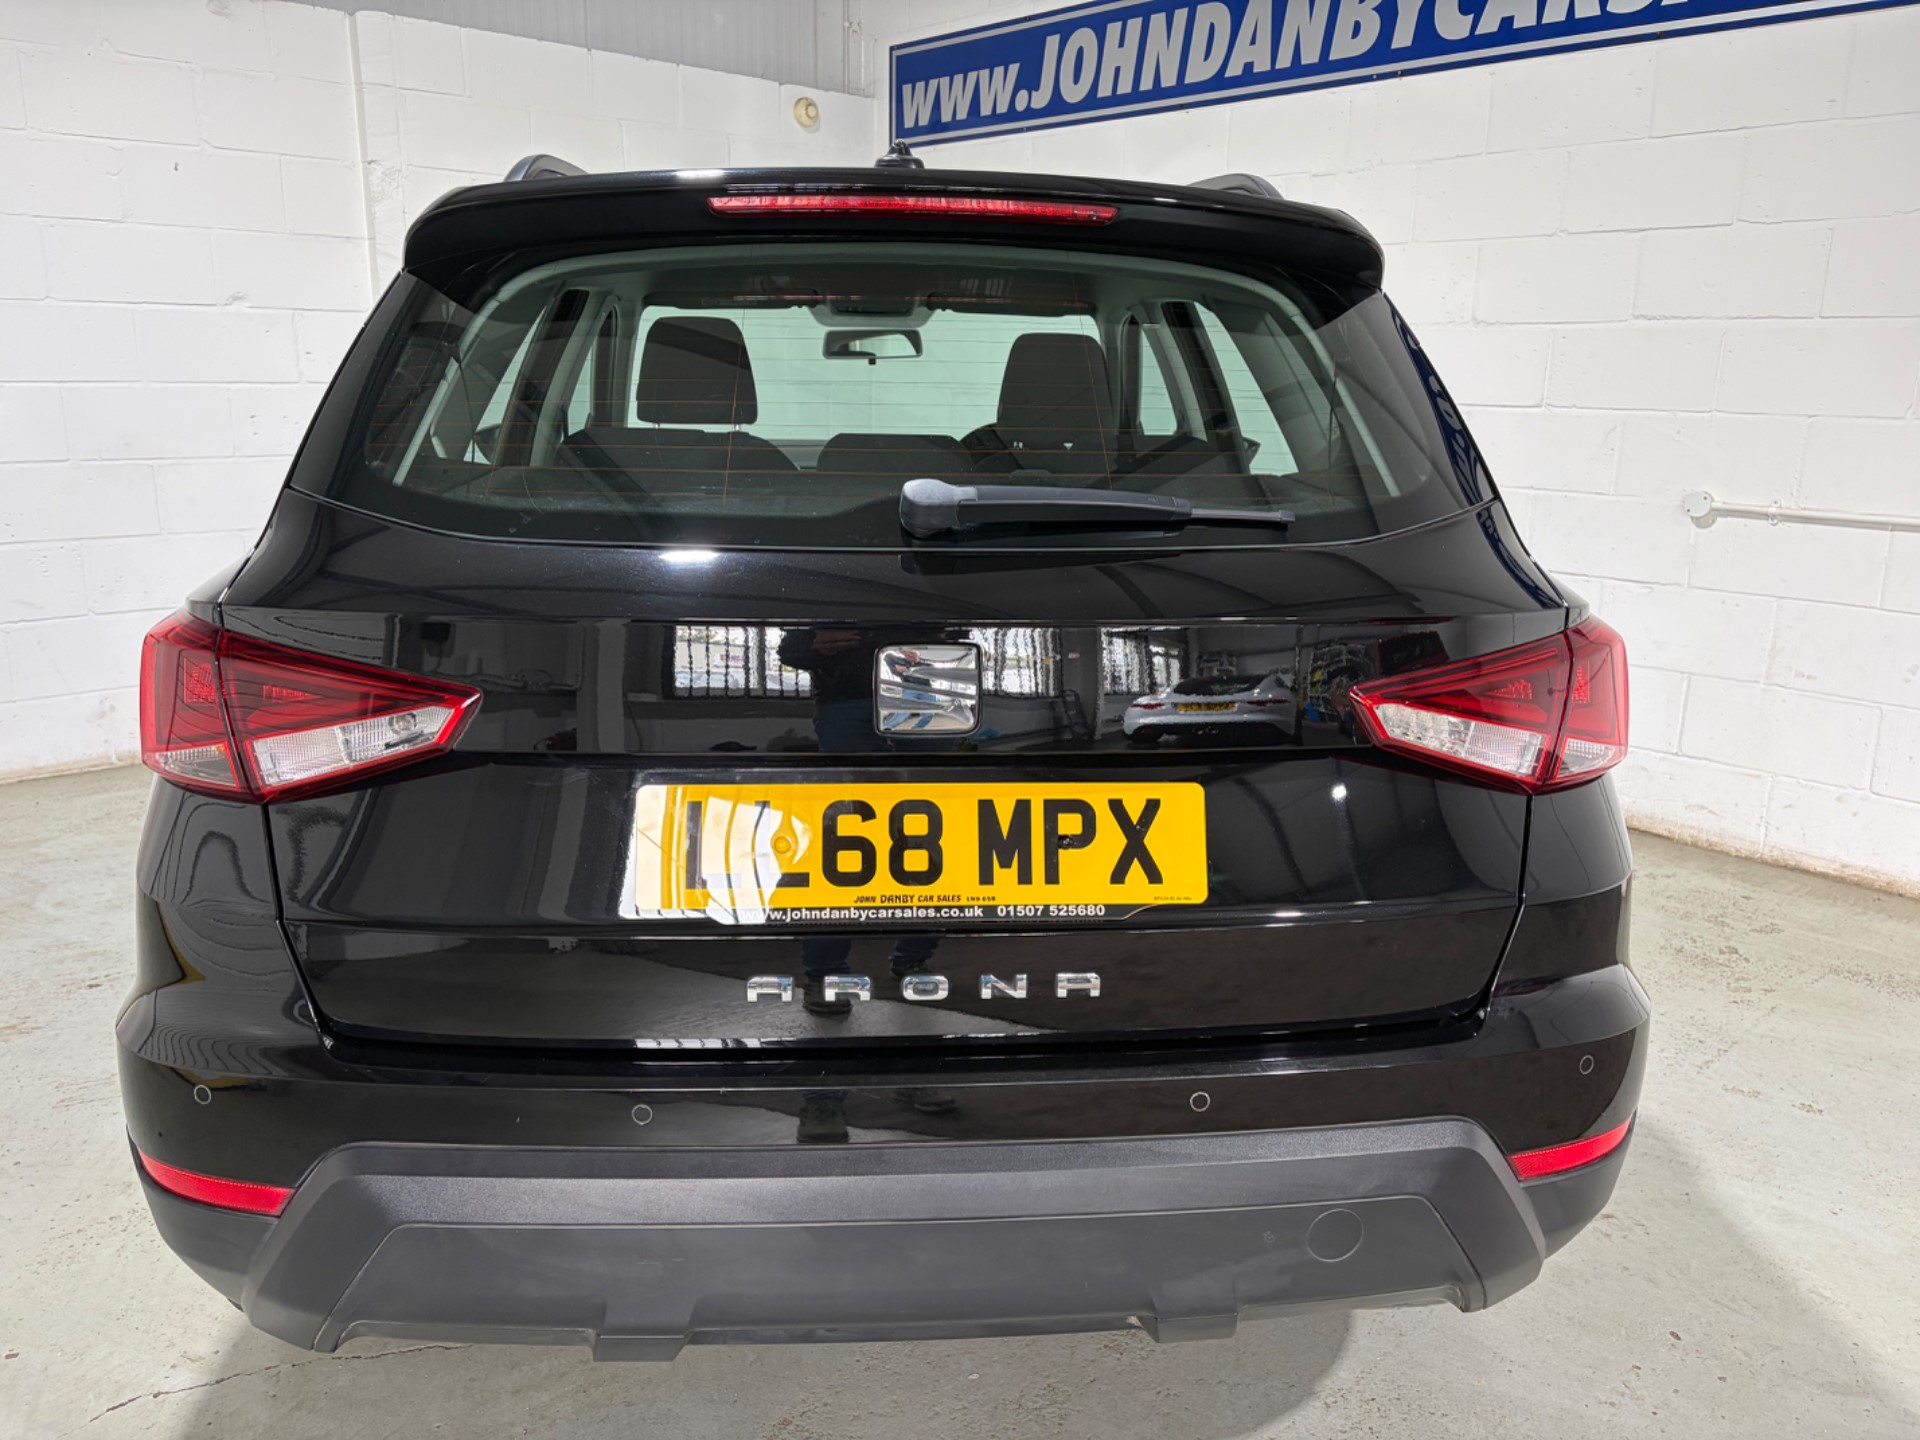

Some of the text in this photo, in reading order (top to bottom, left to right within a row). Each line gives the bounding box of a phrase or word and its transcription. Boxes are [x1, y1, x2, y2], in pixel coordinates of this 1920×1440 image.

[902, 0, 1688, 129] www.JOHNDANBY
[978, 797, 1164, 885] MPX
[854, 896, 876, 904] JOHN
[880, 894, 915, 904] DANBY
[918, 894, 934, 903] CAR
[937, 894, 962, 903] SALES
[997, 905, 1044, 917] 01507
[1049, 904, 1105, 917] 525680
[747, 972, 1100, 1002] ARONA
